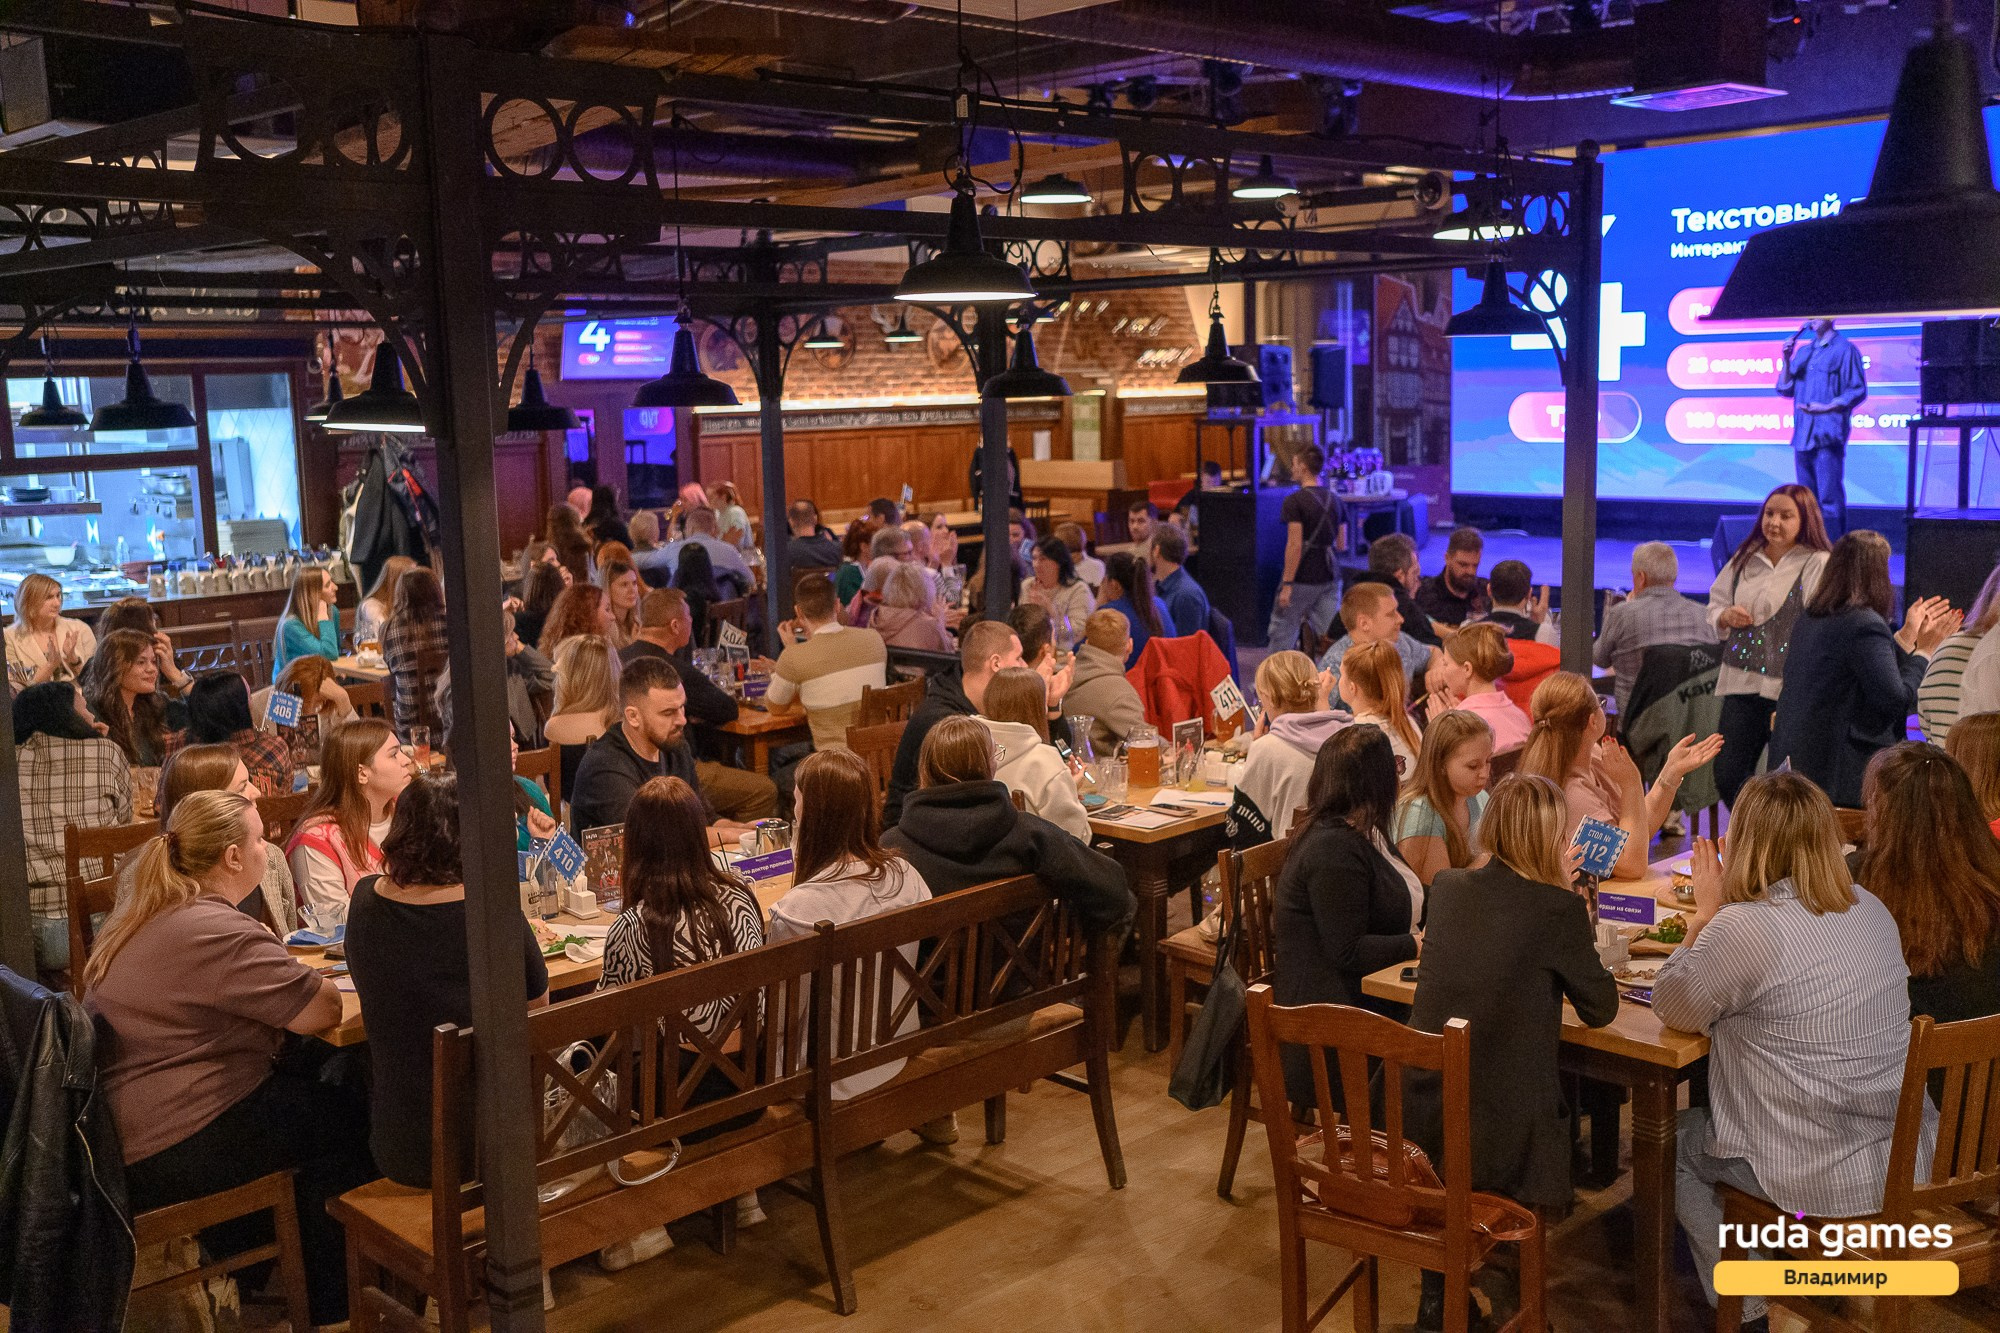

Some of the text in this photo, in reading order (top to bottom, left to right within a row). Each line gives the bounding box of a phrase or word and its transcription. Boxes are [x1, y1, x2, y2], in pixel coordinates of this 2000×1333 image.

[1671, 192, 1842, 234] Текстовый
[578, 320, 611, 352] 4
[1219, 687, 1237, 710] 411
[1678, 679, 1718, 704] Kap
[272, 704, 293, 720] 405
[561, 839, 573, 853] СТОЛ
[1588, 829, 1603, 840] СТОЛ
[553, 847, 575, 872] 410
[1581, 839, 1608, 863] 412
[751, 865, 770, 874] доктор
[769, 859, 793, 869] прописал
